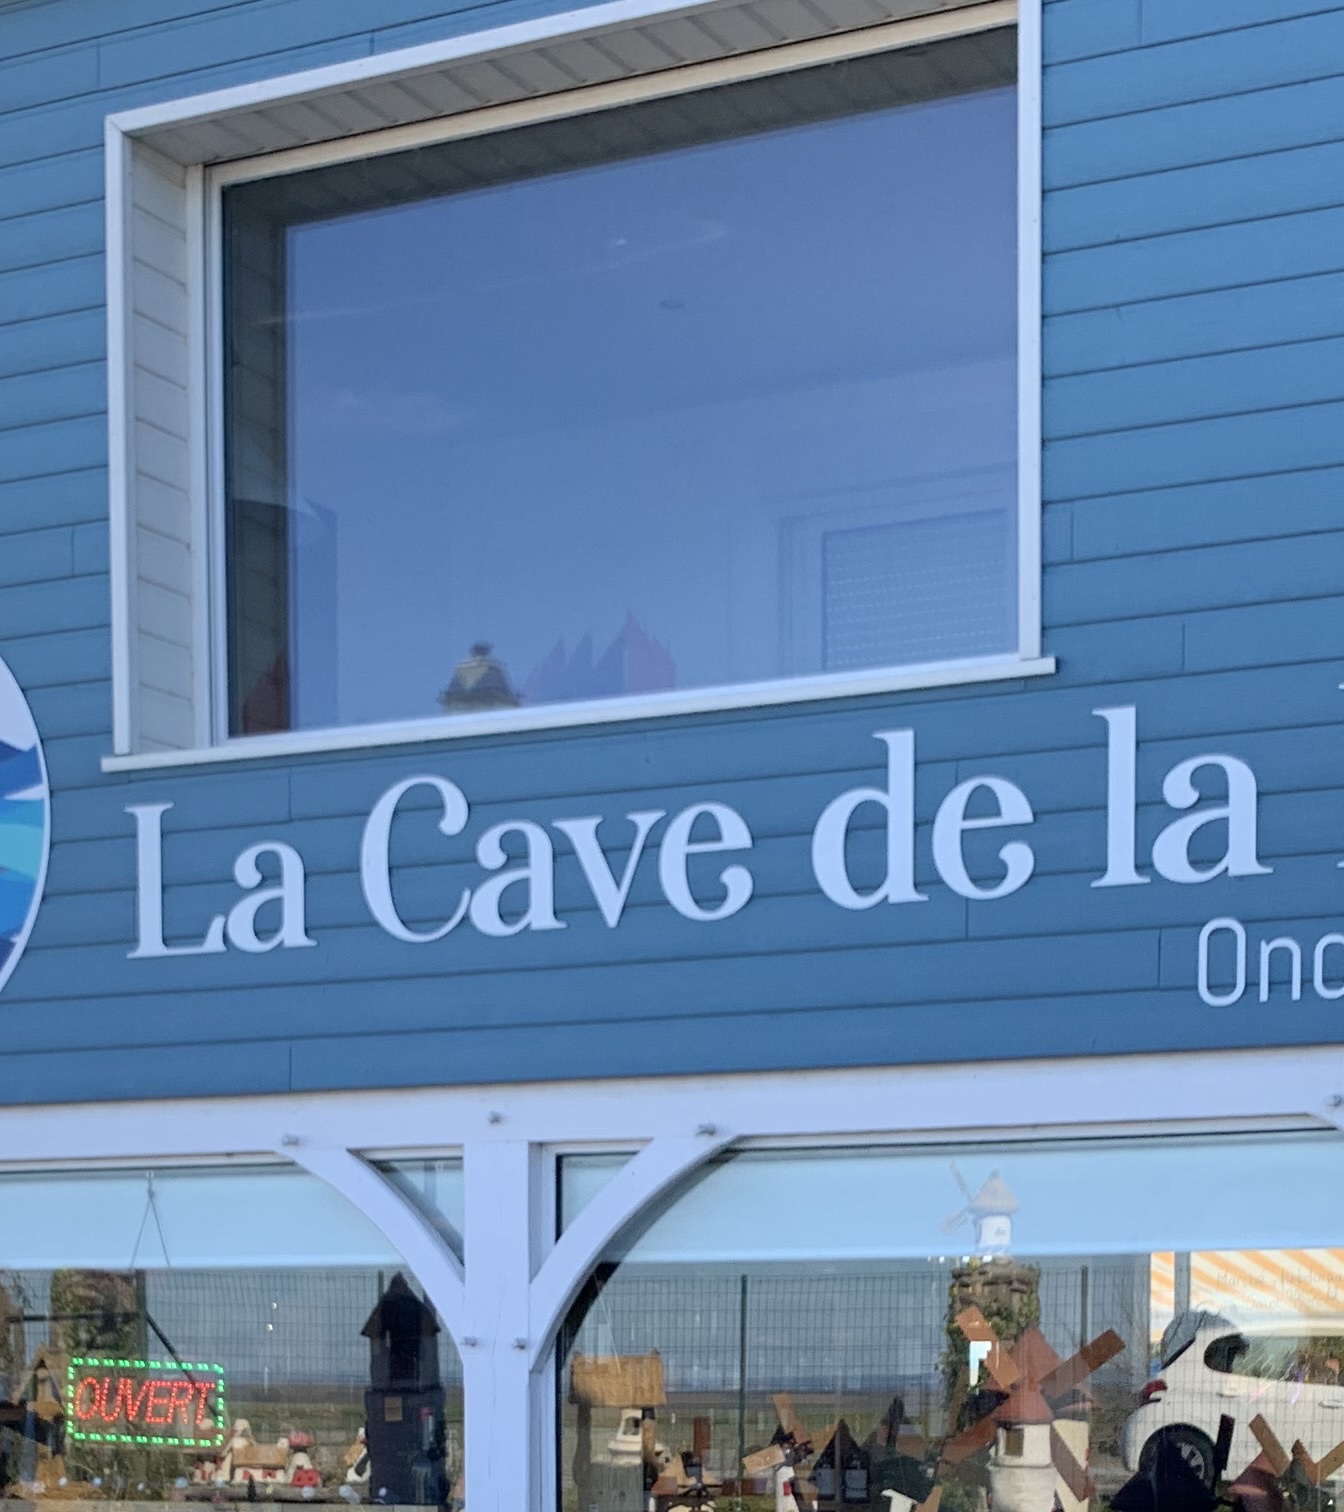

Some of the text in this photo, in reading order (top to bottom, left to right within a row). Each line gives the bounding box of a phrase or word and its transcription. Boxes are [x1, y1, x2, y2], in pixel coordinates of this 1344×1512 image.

[127, 804, 314, 957] La
[362, 777, 752, 942] Cave
[813, 730, 1034, 908] de
[1092, 706, 1272, 886] la
[75, 1377, 216, 1424] OUVERT
